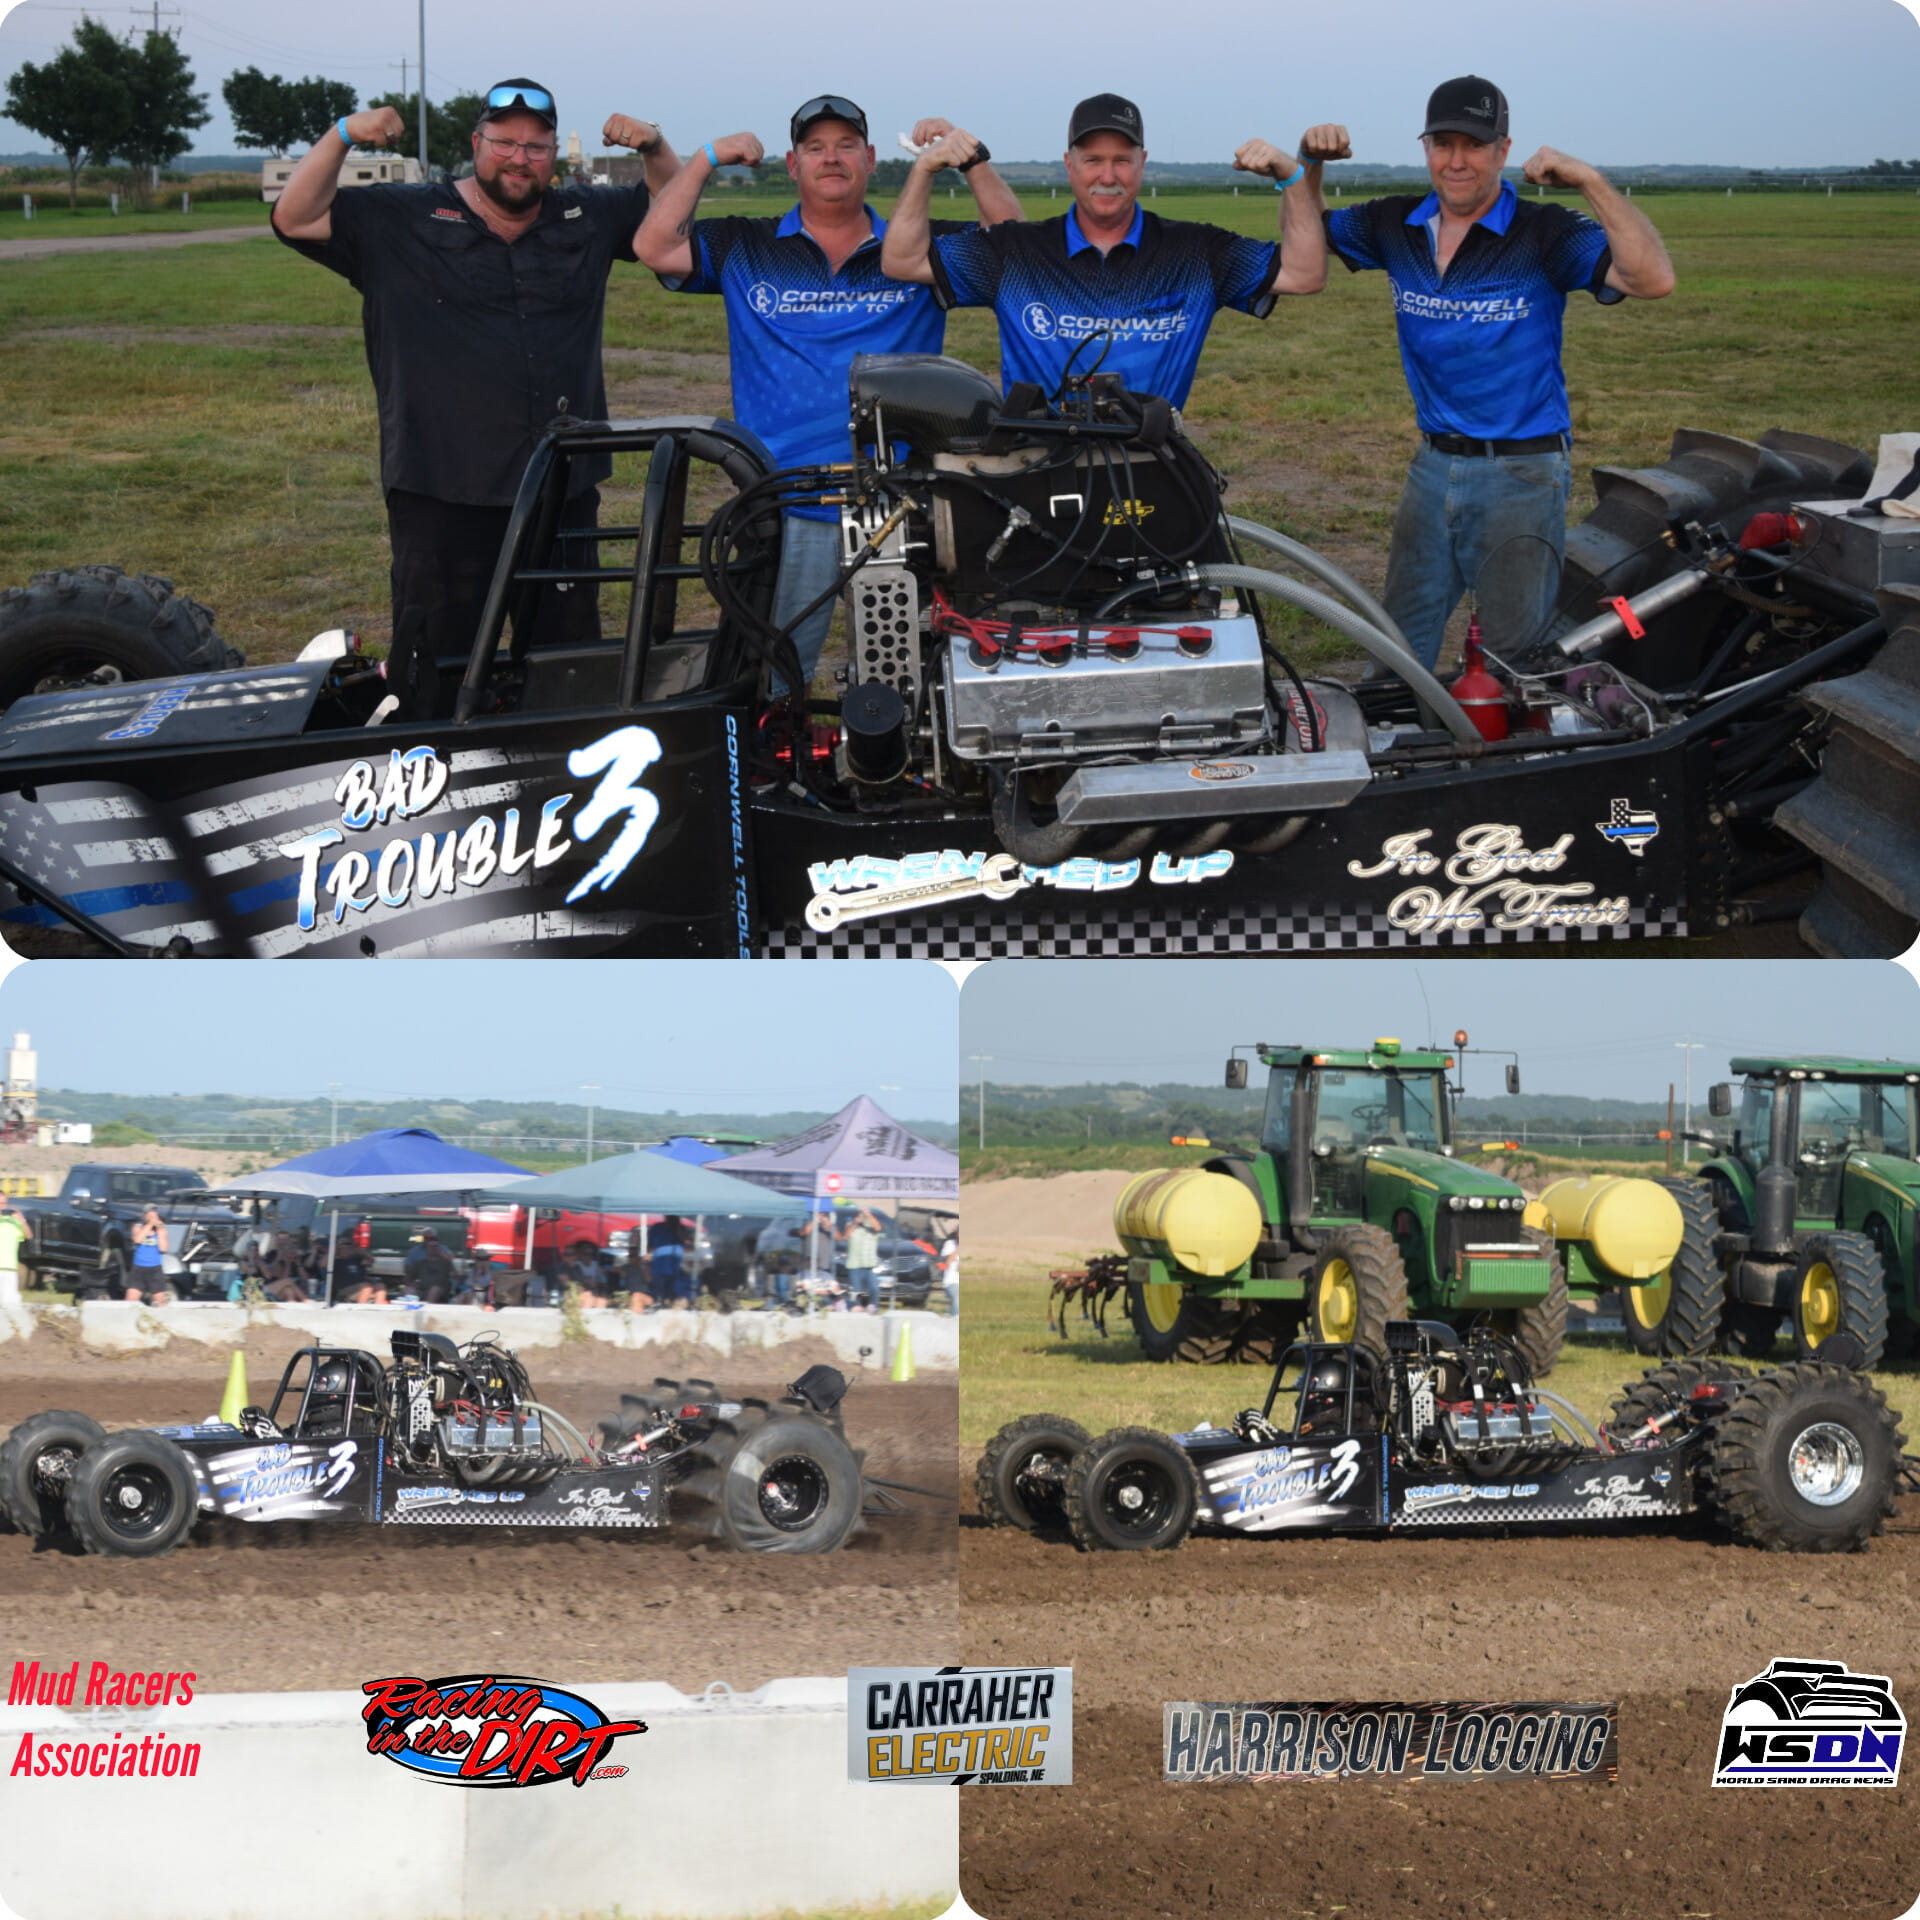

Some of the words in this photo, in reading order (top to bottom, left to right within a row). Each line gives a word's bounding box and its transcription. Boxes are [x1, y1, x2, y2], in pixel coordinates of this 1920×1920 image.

[778, 303, 858, 313] QUALITY
[1402, 291, 1529, 313] CORNWELL
[1402, 303, 1465, 321] QUALITY
[1471, 309, 1529, 323] TOOLS
[334, 745, 451, 830] BAD
[725, 713, 745, 869] CORNWELL
[278, 793, 574, 932] TROUBLE
[566, 725, 664, 905] 3
[1150, 850, 1235, 884] UP
[1347, 828, 1441, 878] In
[1445, 823, 1575, 885] God
[1386, 880, 1486, 935] We
[1492, 881, 1631, 930] Trust
[236, 1461, 330, 1504] TROUBLE
[322, 1439, 358, 1499] 3
[255, 1443, 292, 1471] BAD
[1235, 1463, 1332, 1513] TROUBLE
[1327, 1439, 1362, 1503] 3
[1255, 1445, 1291, 1477] BAD
[1512, 1483, 1540, 1497] UP
